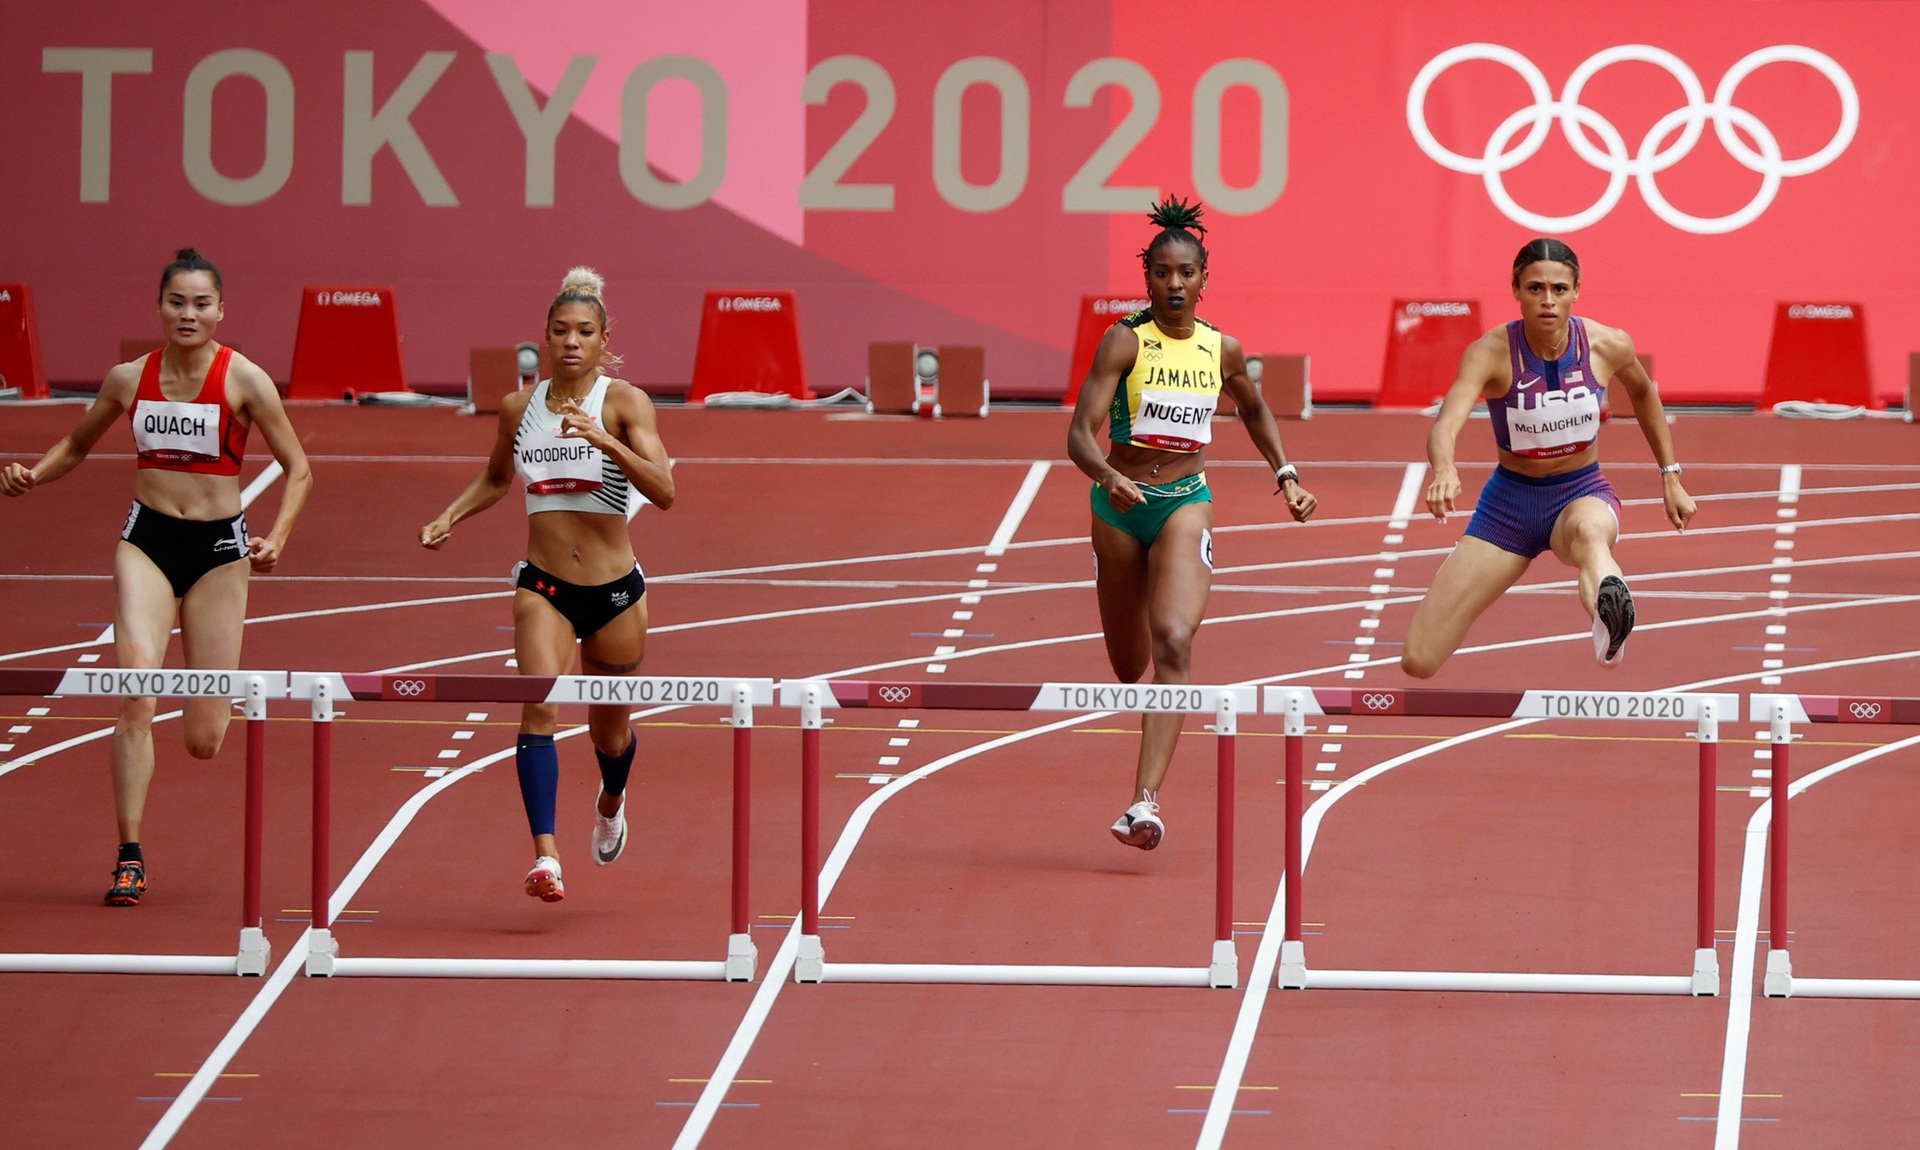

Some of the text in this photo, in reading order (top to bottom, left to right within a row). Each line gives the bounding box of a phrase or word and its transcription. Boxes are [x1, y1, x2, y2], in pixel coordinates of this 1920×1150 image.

[42, 47, 1290, 216] TOKYO 2020
[332, 291, 382, 306] OMEGA
[732, 297, 782, 312] OMEGA
[1108, 299, 1152, 314] OMEG
[1422, 302, 1472, 316] OMEGA
[1804, 304, 1854, 319] OMEGA
[1144, 366, 1217, 389] JAMAICA
[1143, 402, 1212, 425] NUGENT
[1515, 413, 1592, 433] McLAUGHLIN
[144, 415, 205, 436] QUACH
[1156, 438, 1170, 446] TOKYO
[521, 446, 595, 463] WOODRUFF
[84, 672, 231, 695] TOKYO 2020
[574, 679, 719, 702] TOKYO 2020
[1059, 687, 1202, 710] TOKYO 2020
[1541, 695, 1685, 718] TOKYO 2020
